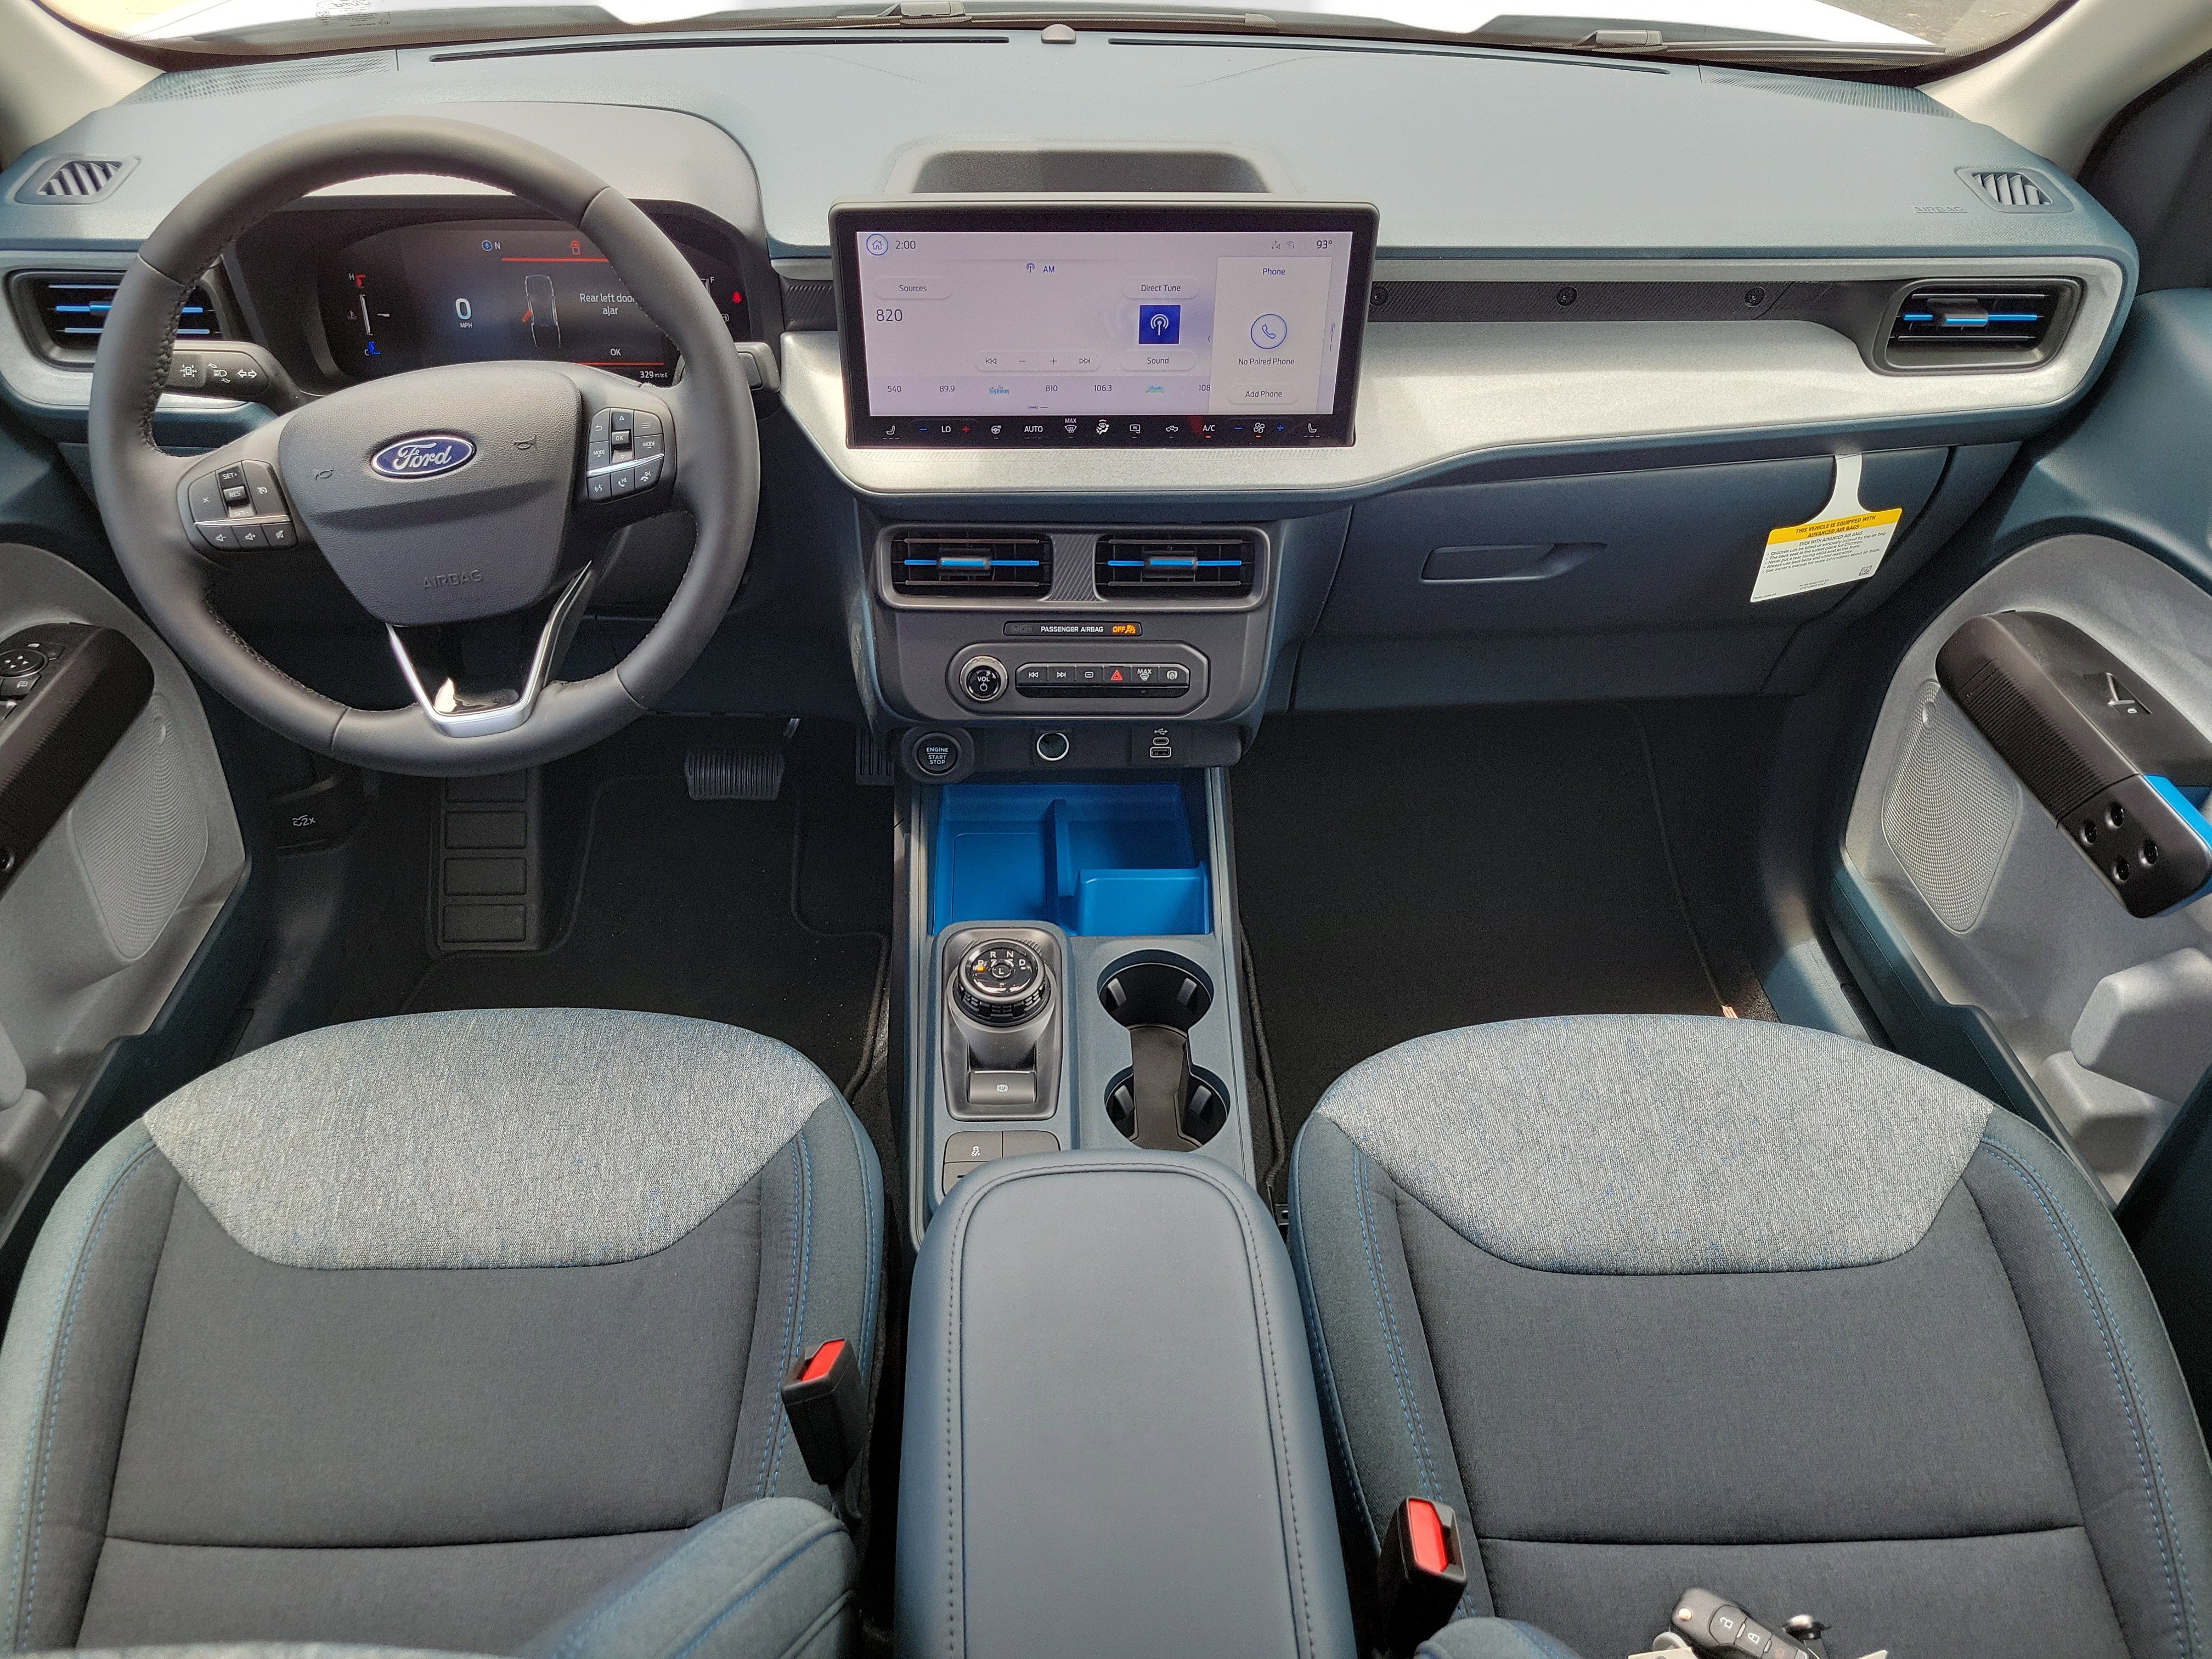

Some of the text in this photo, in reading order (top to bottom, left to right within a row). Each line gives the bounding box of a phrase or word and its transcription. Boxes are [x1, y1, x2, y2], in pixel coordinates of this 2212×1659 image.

[494, 241, 501, 250] N
[895, 240, 916, 250] 2:00
[1316, 240, 1333, 249] 93°
[1262, 267, 1285, 276] Phone
[899, 284, 927, 292] Sources
[580, 293, 599, 302] Rear
[600, 293, 615, 302] left
[455, 298, 472, 320] 0
[602, 306, 618, 316] ajar
[876, 309, 903, 322] 820
[393, 442, 452, 470] Ford
[1808, 529, 1835, 537] ADVANCED
[423, 569, 483, 590] AIRBAG
